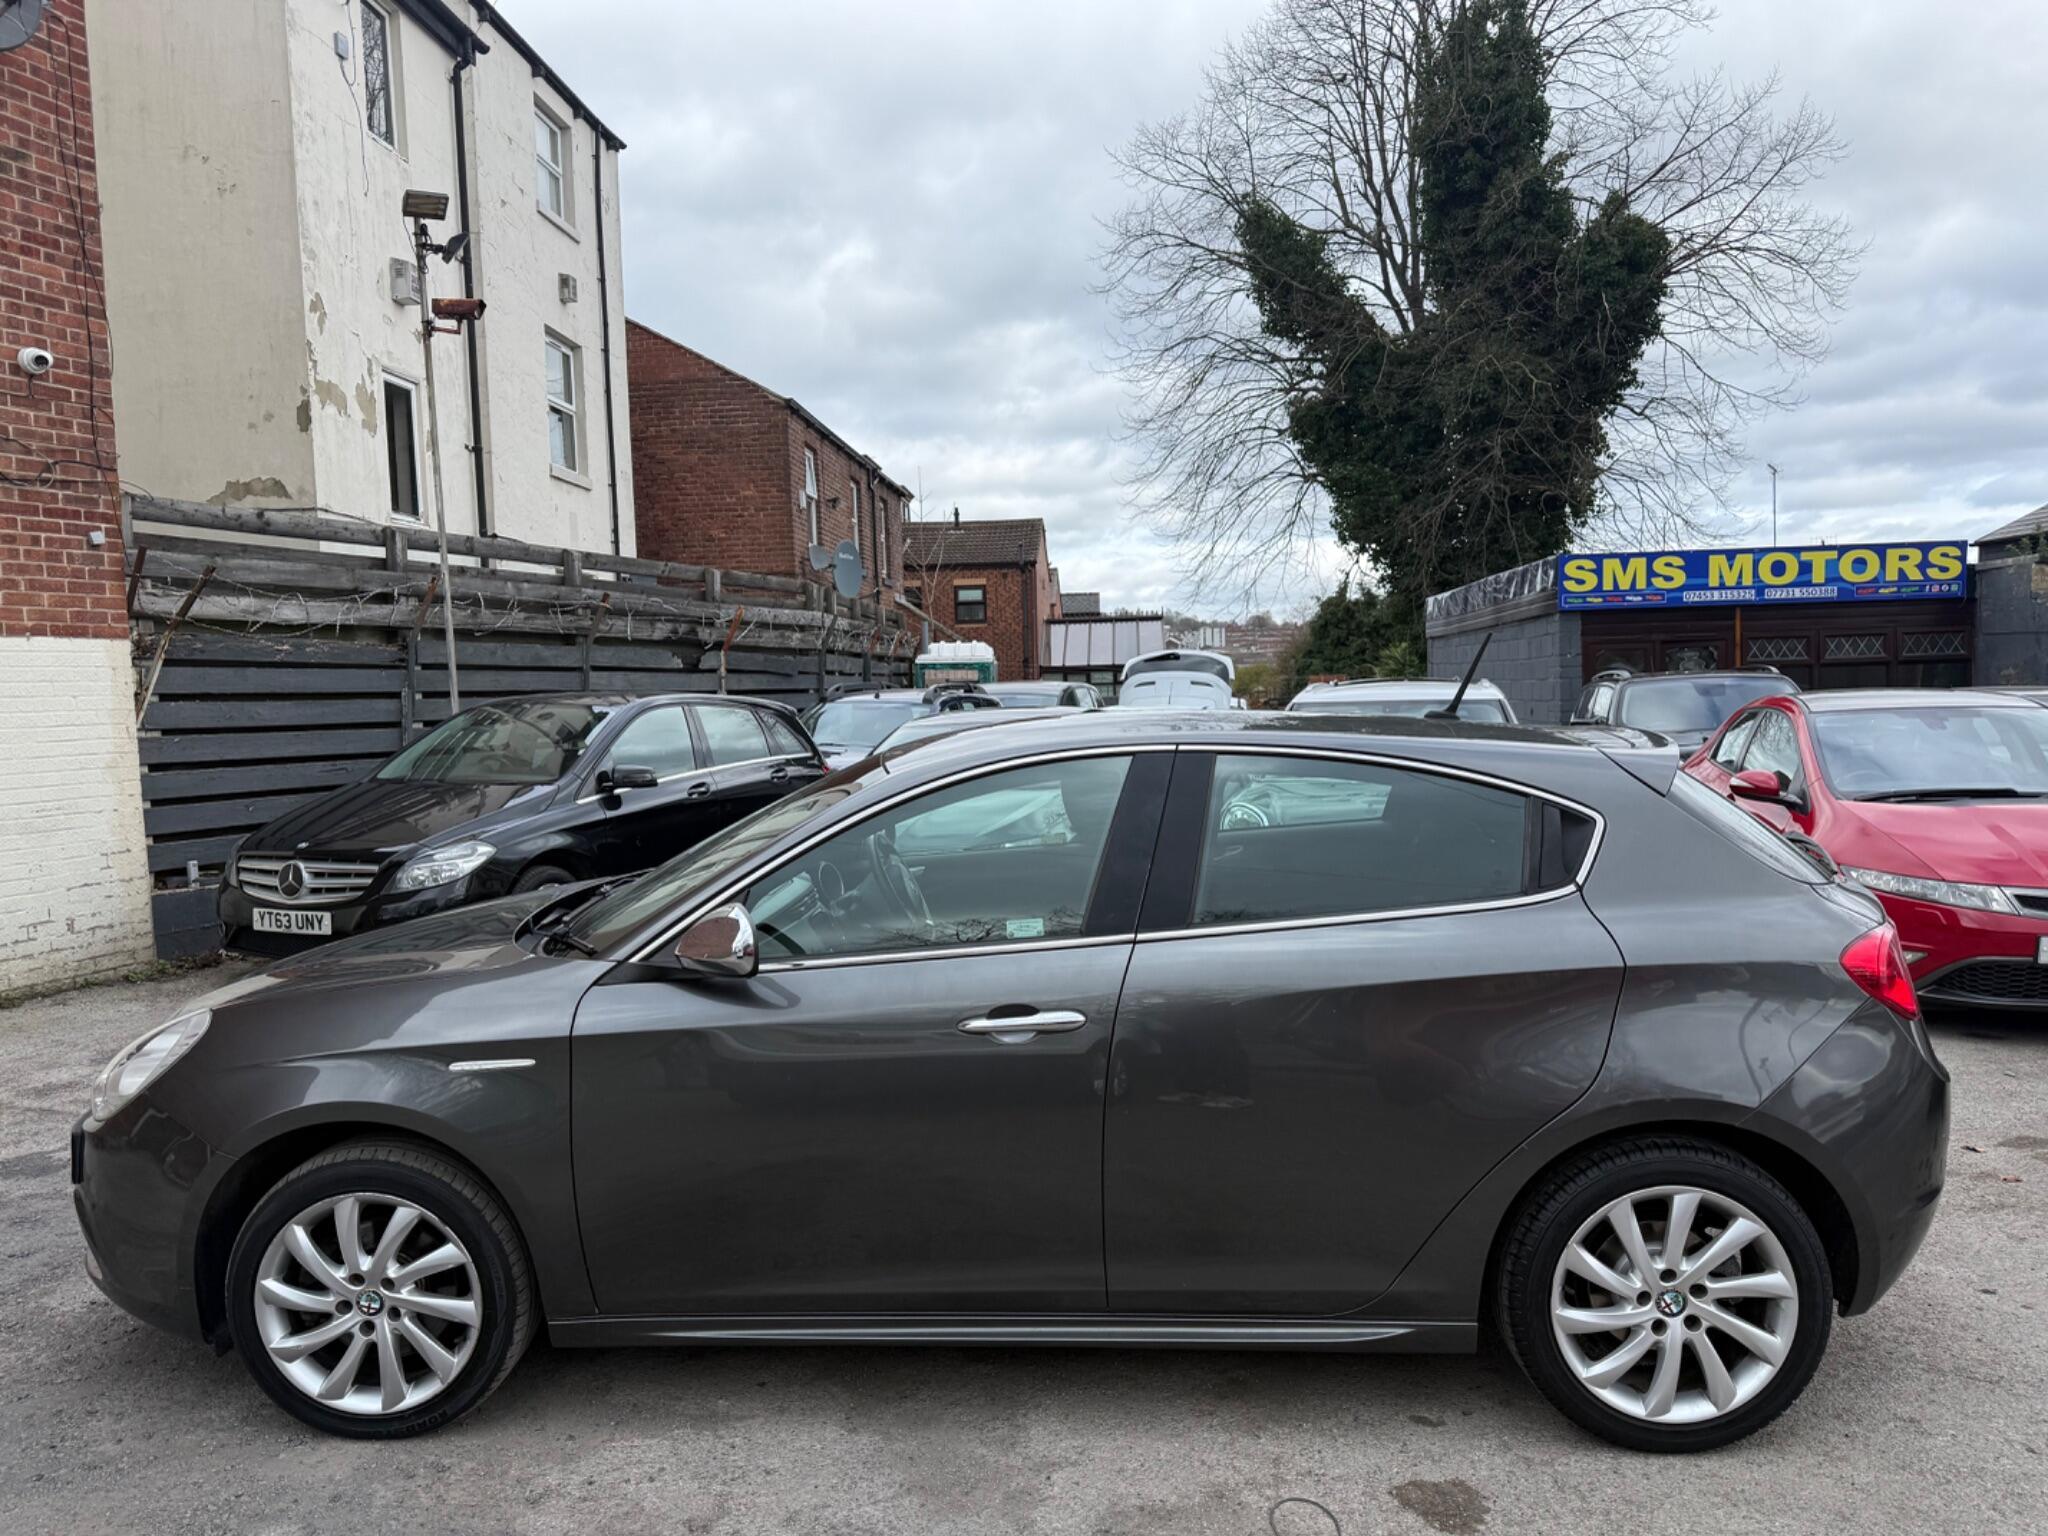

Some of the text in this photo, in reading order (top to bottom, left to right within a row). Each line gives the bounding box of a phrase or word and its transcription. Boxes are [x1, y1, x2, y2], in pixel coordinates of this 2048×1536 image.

[1562, 546, 1963, 592] SMS MOTORS
[258, 911, 324, 931] YT63 UNY
